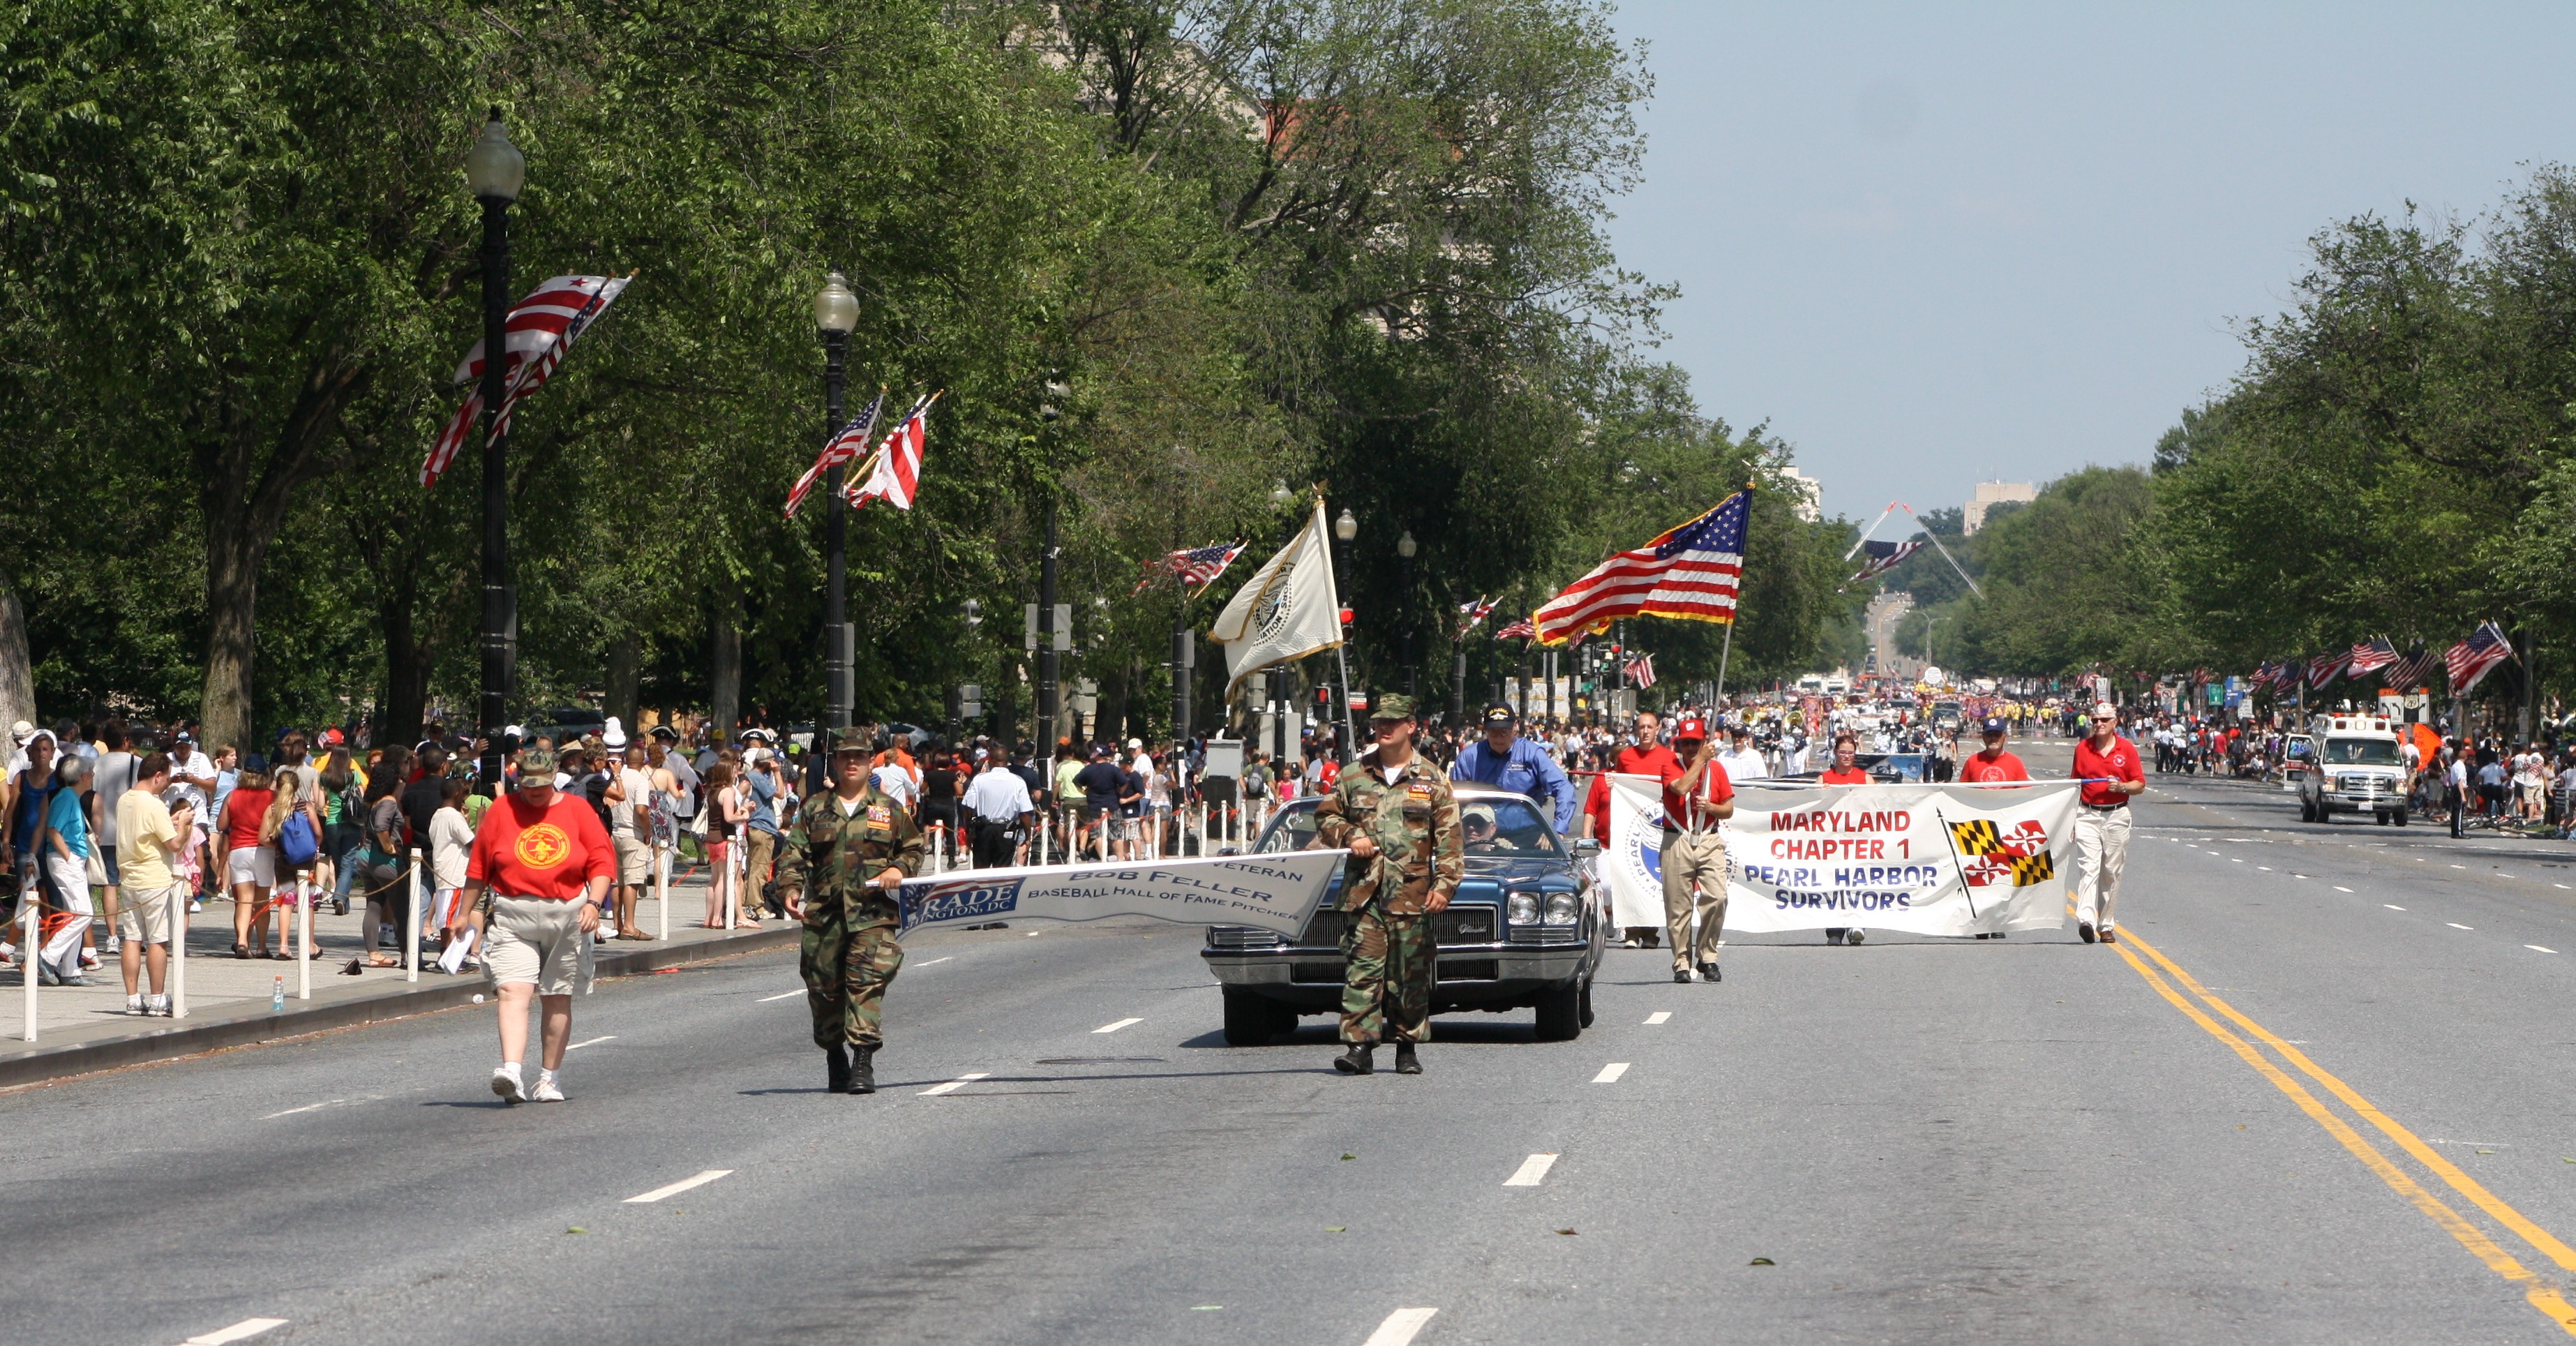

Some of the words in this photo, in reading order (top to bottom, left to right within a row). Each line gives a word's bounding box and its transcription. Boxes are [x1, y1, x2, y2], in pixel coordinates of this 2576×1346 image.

[1256, 615, 1283, 641] IATION
[1770, 810, 1910, 832] MARYLAND
[1630, 831, 1647, 876] PEARL
[1771, 839, 1885, 860] CHAPTER
[1897, 838, 1910, 860] 1
[1068, 871, 1139, 881] BOB
[1148, 871, 1273, 903] FELLER
[1744, 865, 1822, 887] PEARL
[1835, 865, 1938, 887] HARBOR
[906, 904, 983, 928] HINGTON,
[987, 899, 1010, 911] DC
[922, 885, 1014, 918] RADE
[1028, 887, 1109, 899] BASEBALL
[1113, 886, 1155, 898] HALL
[1184, 893, 1228, 906] FAME
[1231, 901, 1299, 920] PITCHER
[1775, 889, 1910, 911] SURVIVORS
